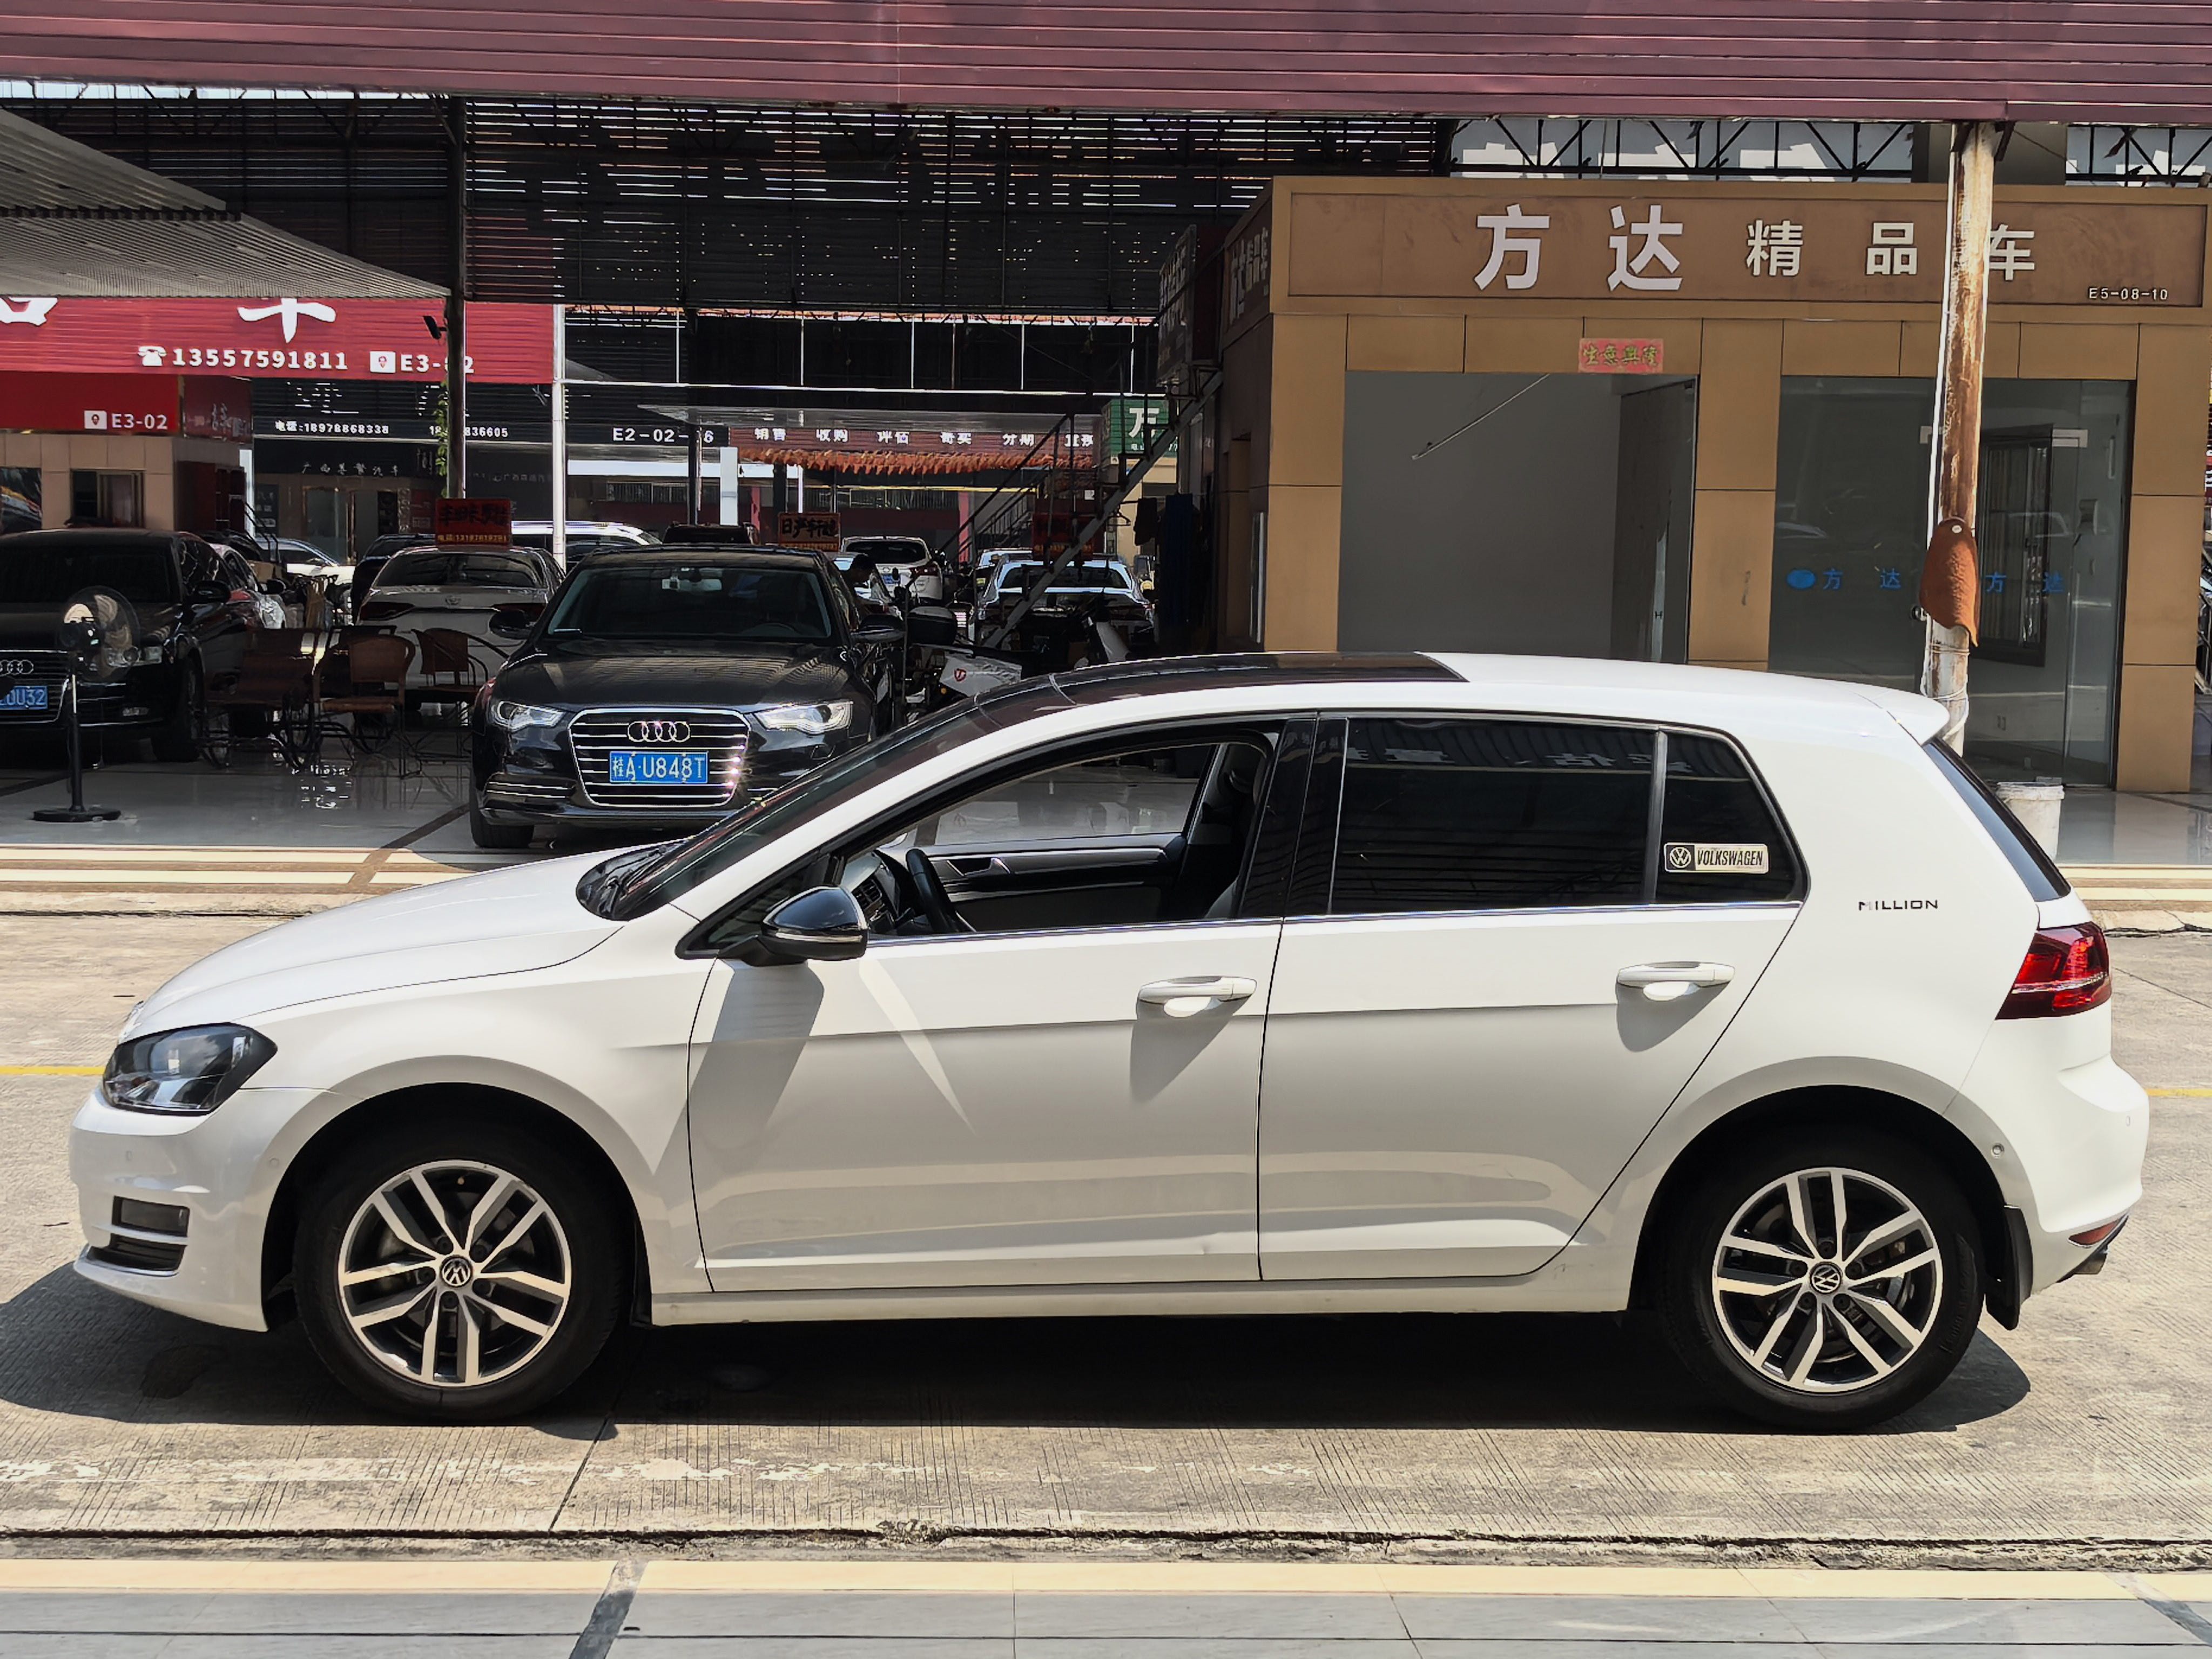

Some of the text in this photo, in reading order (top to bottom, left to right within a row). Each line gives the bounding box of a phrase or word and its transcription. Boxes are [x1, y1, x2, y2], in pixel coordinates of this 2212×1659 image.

[2088, 287, 2168, 301] E5-08-10
[172, 348, 348, 370] 13557591811
[401, 354, 474, 373] E3-2
[112, 414, 167, 429] E3-02
[613, 427, 713, 443] E2-02-6
[816, 429, 848, 442] 收购
[877, 430, 909, 444] 评估
[1003, 434, 1034, 446] 分期
[1823, 568, 1901, 590] 方达
[1697, 850, 1763, 865] VOLKSWAGEN
[1859, 900, 1938, 911] MILLION
